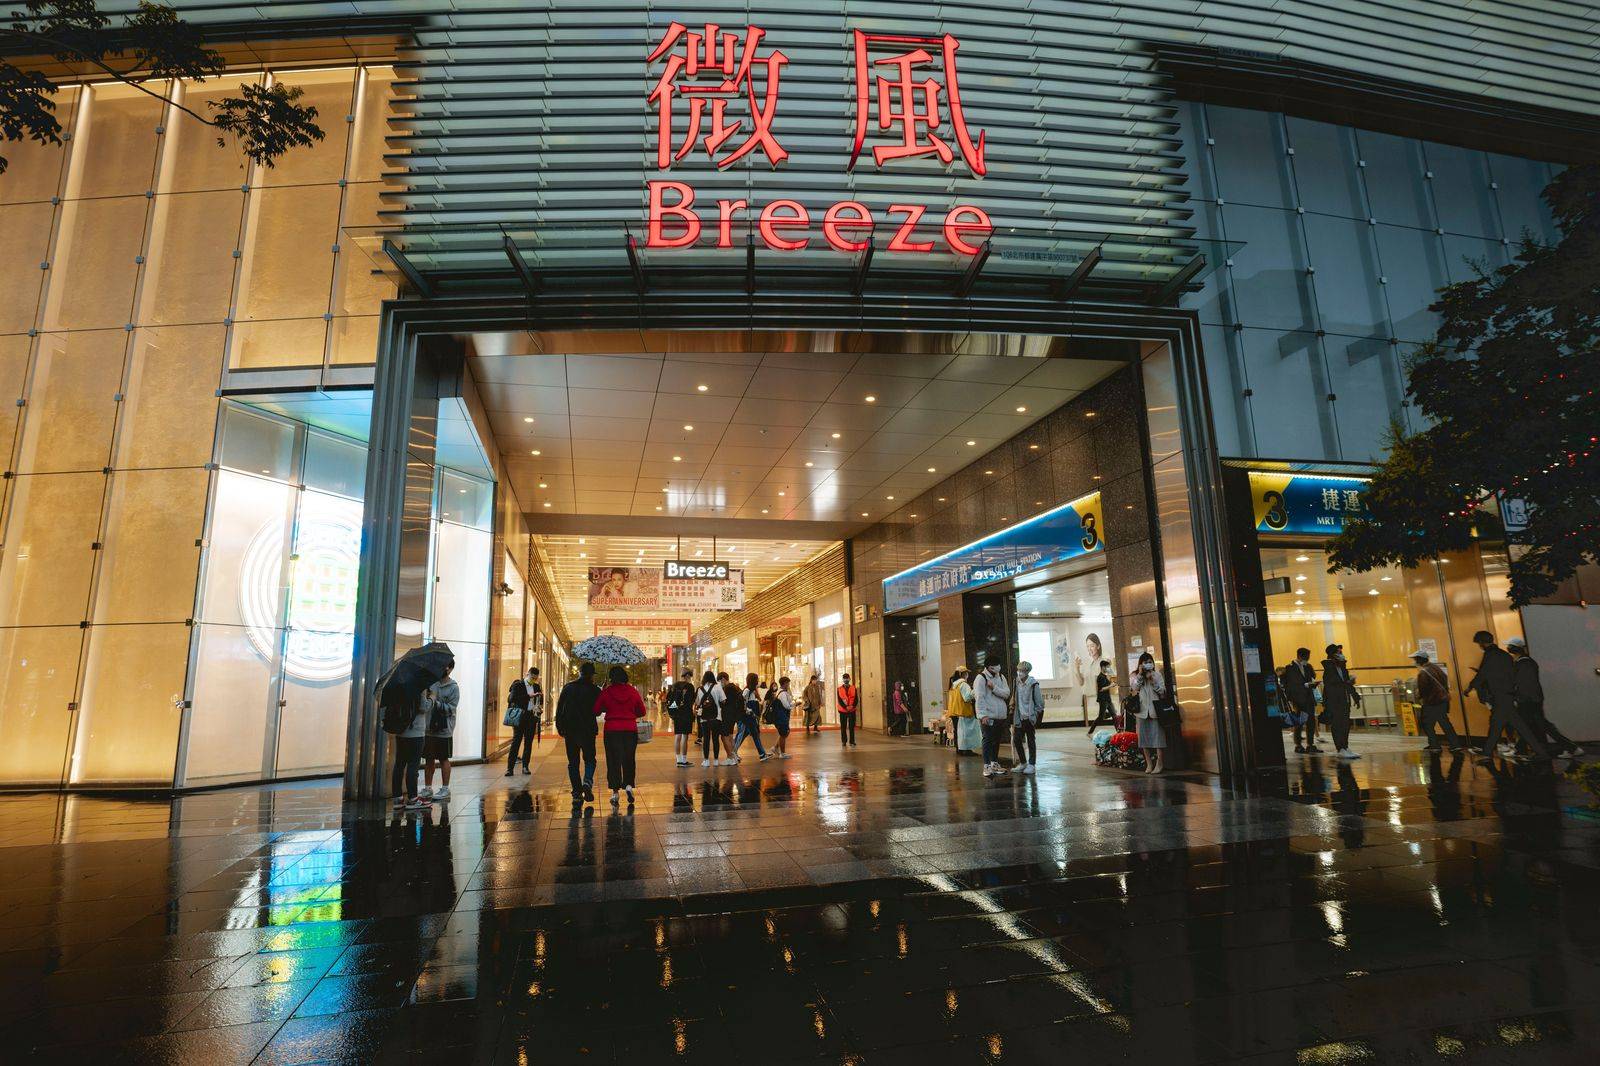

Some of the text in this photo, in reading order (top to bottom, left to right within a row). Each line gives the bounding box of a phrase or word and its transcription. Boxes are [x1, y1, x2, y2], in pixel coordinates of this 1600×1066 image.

[647, 21, 987, 180] 微風
[646, 180, 993, 255] Breeze
[1262, 490, 1288, 531] 3
[1321, 488, 1369, 511] 捷運
[1080, 512, 1098, 552] 3
[1316, 517, 1335, 525] MRT
[667, 562, 727, 578] Breeze
[592, 597, 613, 606] SUPER
[614, 597, 658, 606] ANNIVERSARY
